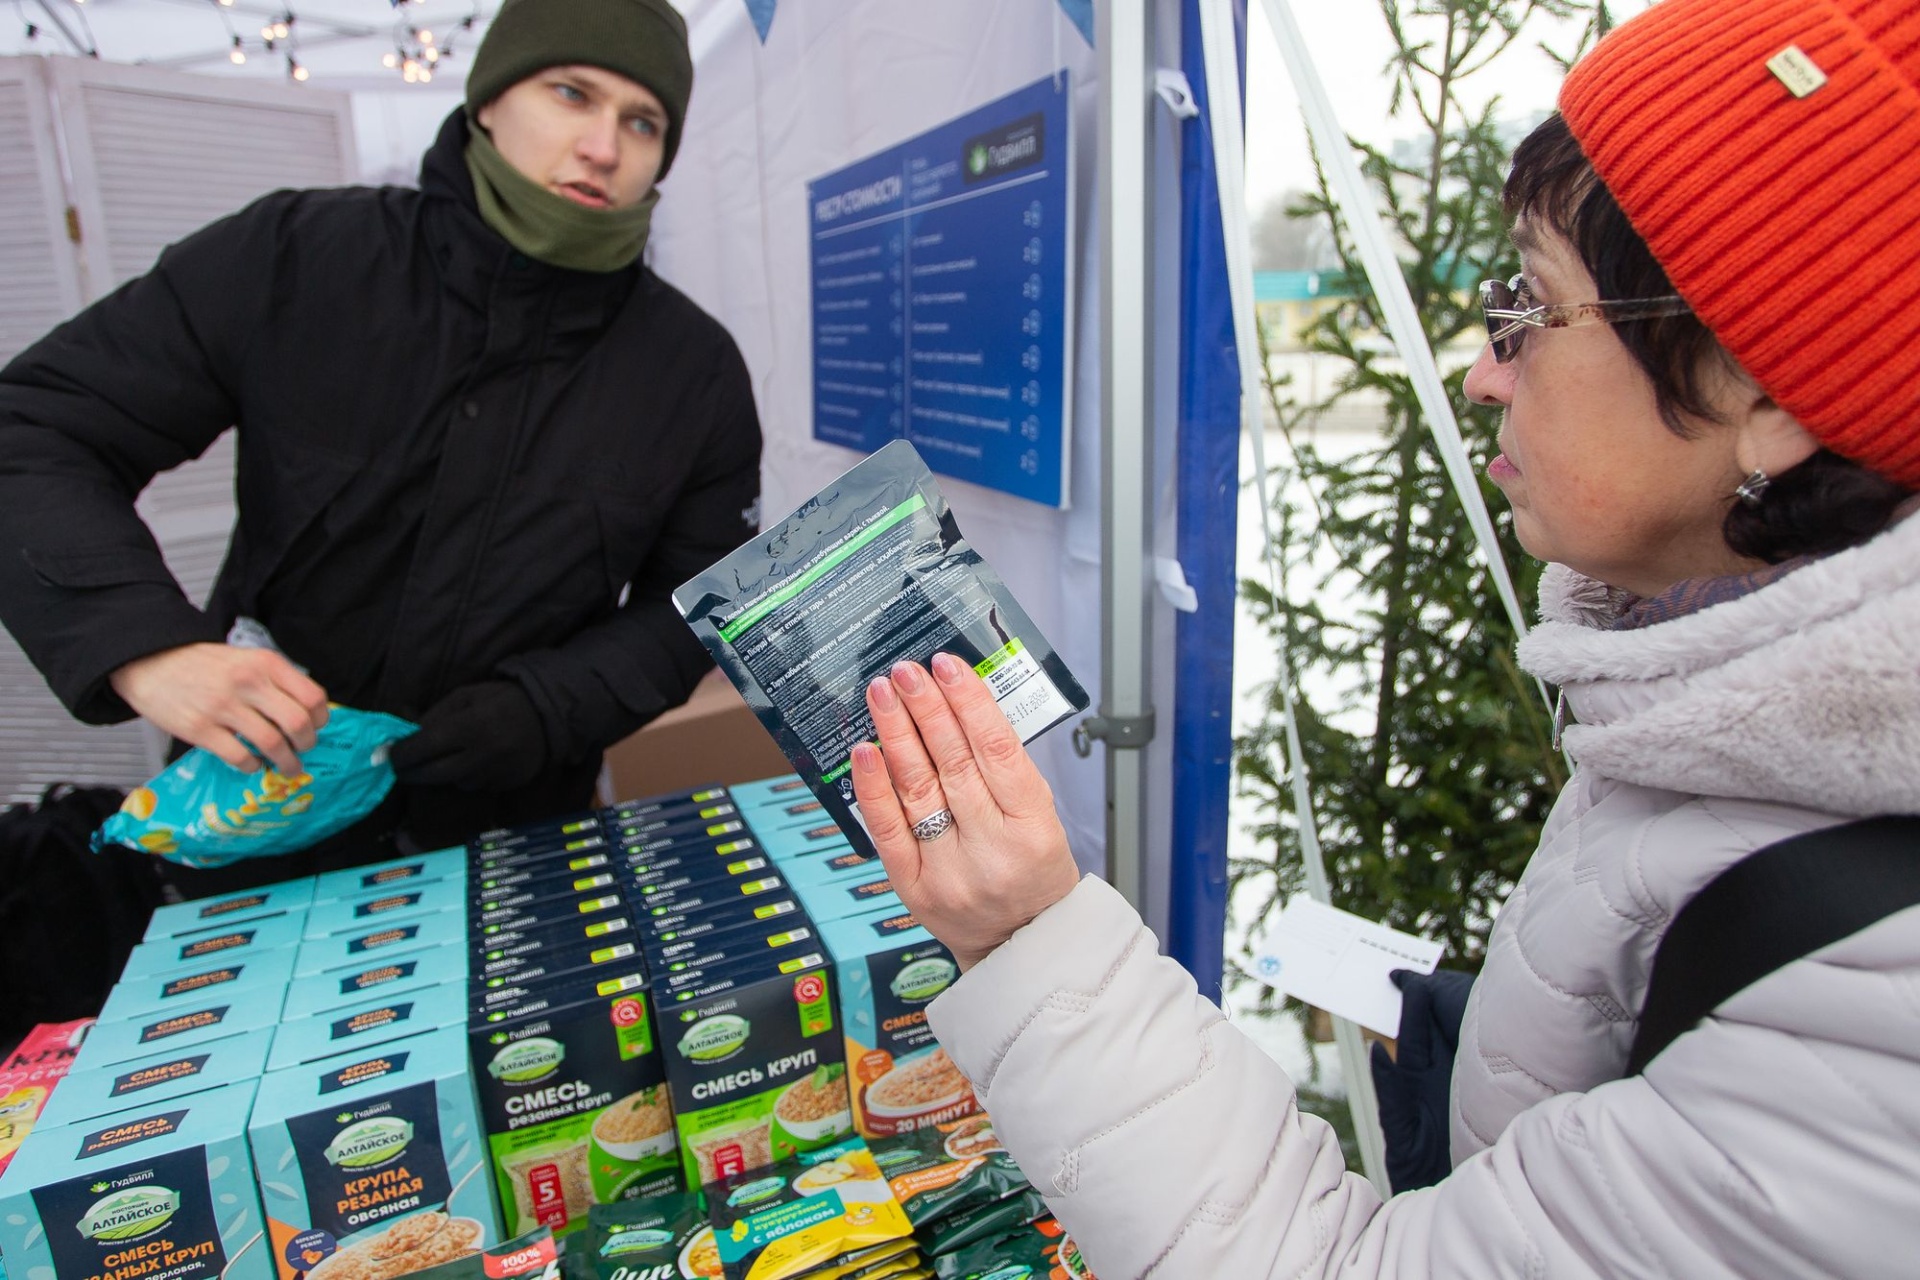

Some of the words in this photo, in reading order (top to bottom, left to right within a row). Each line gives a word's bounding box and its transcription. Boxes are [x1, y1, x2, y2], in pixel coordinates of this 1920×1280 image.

[810, 538, 844, 565] требующие
[843, 524, 863, 541] варки,
[865, 503, 890, 524] тыквой.
[836, 619, 862, 641] ашкабак
[861, 606, 881, 623] менен
[840, 724, 855, 738] даты
[882, 1010, 928, 1032] СМЕС
[130, 1061, 192, 1081] СМЕСЬ
[692, 1068, 764, 1100] СМЕСЬ
[767, 1048, 817, 1078] КРУП
[505, 1080, 591, 1115] СМЕСЬ
[508, 1103, 575, 1129] резаных
[576, 1092, 612, 1110] круп
[100, 1118, 168, 1141] СМЕСЬ
[896, 1118, 914, 1133] 20
[918, 1100, 972, 1129] МИНУТ
[88, 1133, 142, 1151] резаных
[144, 1125, 173, 1137] круп
[338, 1133, 405, 1158] АЛТАЙСКОЕ
[111, 1171, 154, 1188] Гудвилл
[344, 1166, 410, 1196] КРУПА
[723, 1162, 738, 1175] 5
[337, 1177, 423, 1214] РЕЗАНАЯ
[539, 1181, 555, 1203] 5
[92, 1202, 171, 1231] АЛТАЙСКОЕ
[348, 1196, 420, 1225] овсяная
[766, 1208, 835, 1239] яблоком
[104, 1239, 174, 1267] СМЕСЬ
[165, 1241, 215, 1267] КРУП
[501, 1247, 541, 1268] 100%
